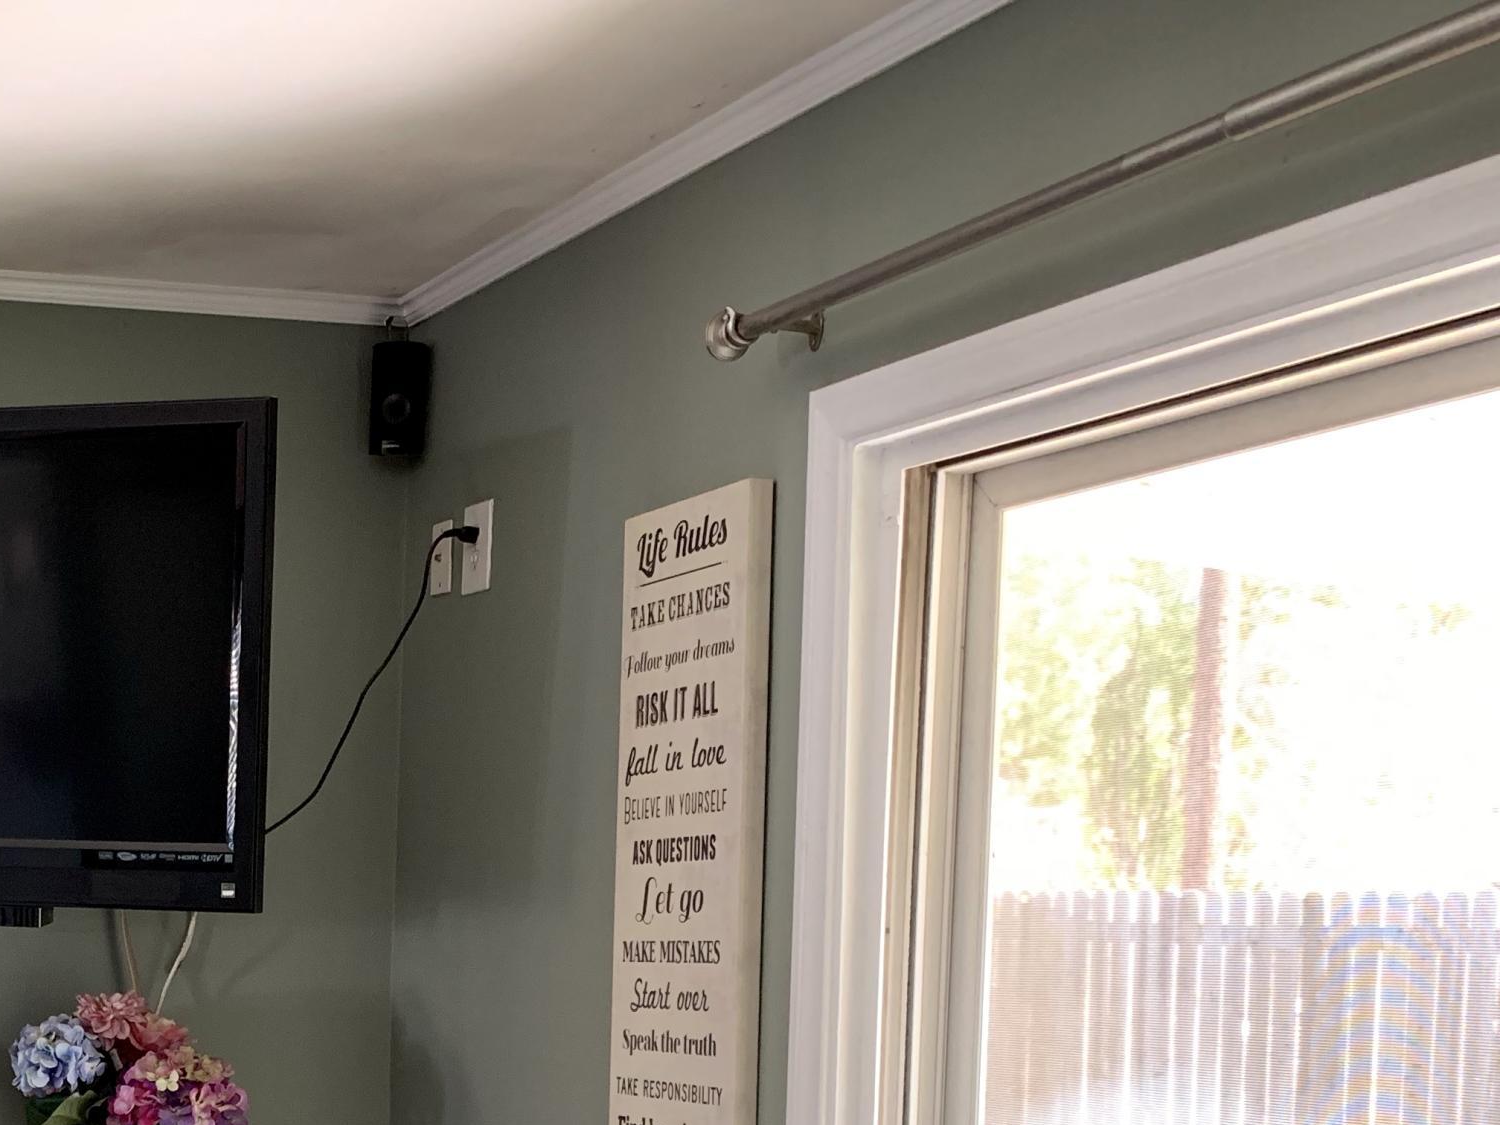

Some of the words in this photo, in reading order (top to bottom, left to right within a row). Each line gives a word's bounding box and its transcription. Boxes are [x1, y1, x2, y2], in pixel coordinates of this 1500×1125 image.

[637, 528, 668, 578] Life
[674, 514, 727, 558] Rules
[630, 600, 665, 631] TAKE
[668, 581, 730, 622] CHANCES
[624, 650, 662, 679] Follow
[665, 649, 690, 673] your
[693, 637, 735, 661] dreams
[636, 690, 668, 728] RISK
[673, 686, 687, 722] IT
[692, 680, 719, 720] ALL
[625, 744, 659, 787] fall
[665, 740, 684, 772] in
[691, 737, 727, 768] love
[624, 796, 661, 825] BELIEVE
[665, 794, 675, 816] IN
[679, 788, 728, 816] YOURSELF
[632, 839, 653, 865] ASK
[655, 833, 717, 867] QUESTIONS
[635, 877, 675, 925] Let
[678, 889, 704, 924] go
[622, 940, 656, 963] MAKE
[659, 940, 721, 964] MISTAKES
[629, 977, 671, 1012] Start
[676, 988, 709, 1012] over
[622, 1028, 658, 1056] Speak
[661, 1030, 681, 1054] the
[683, 1033, 717, 1057] truth
[616, 1076, 639, 1096] TAKE
[643, 1079, 723, 1107] RESPONSIBILITY
